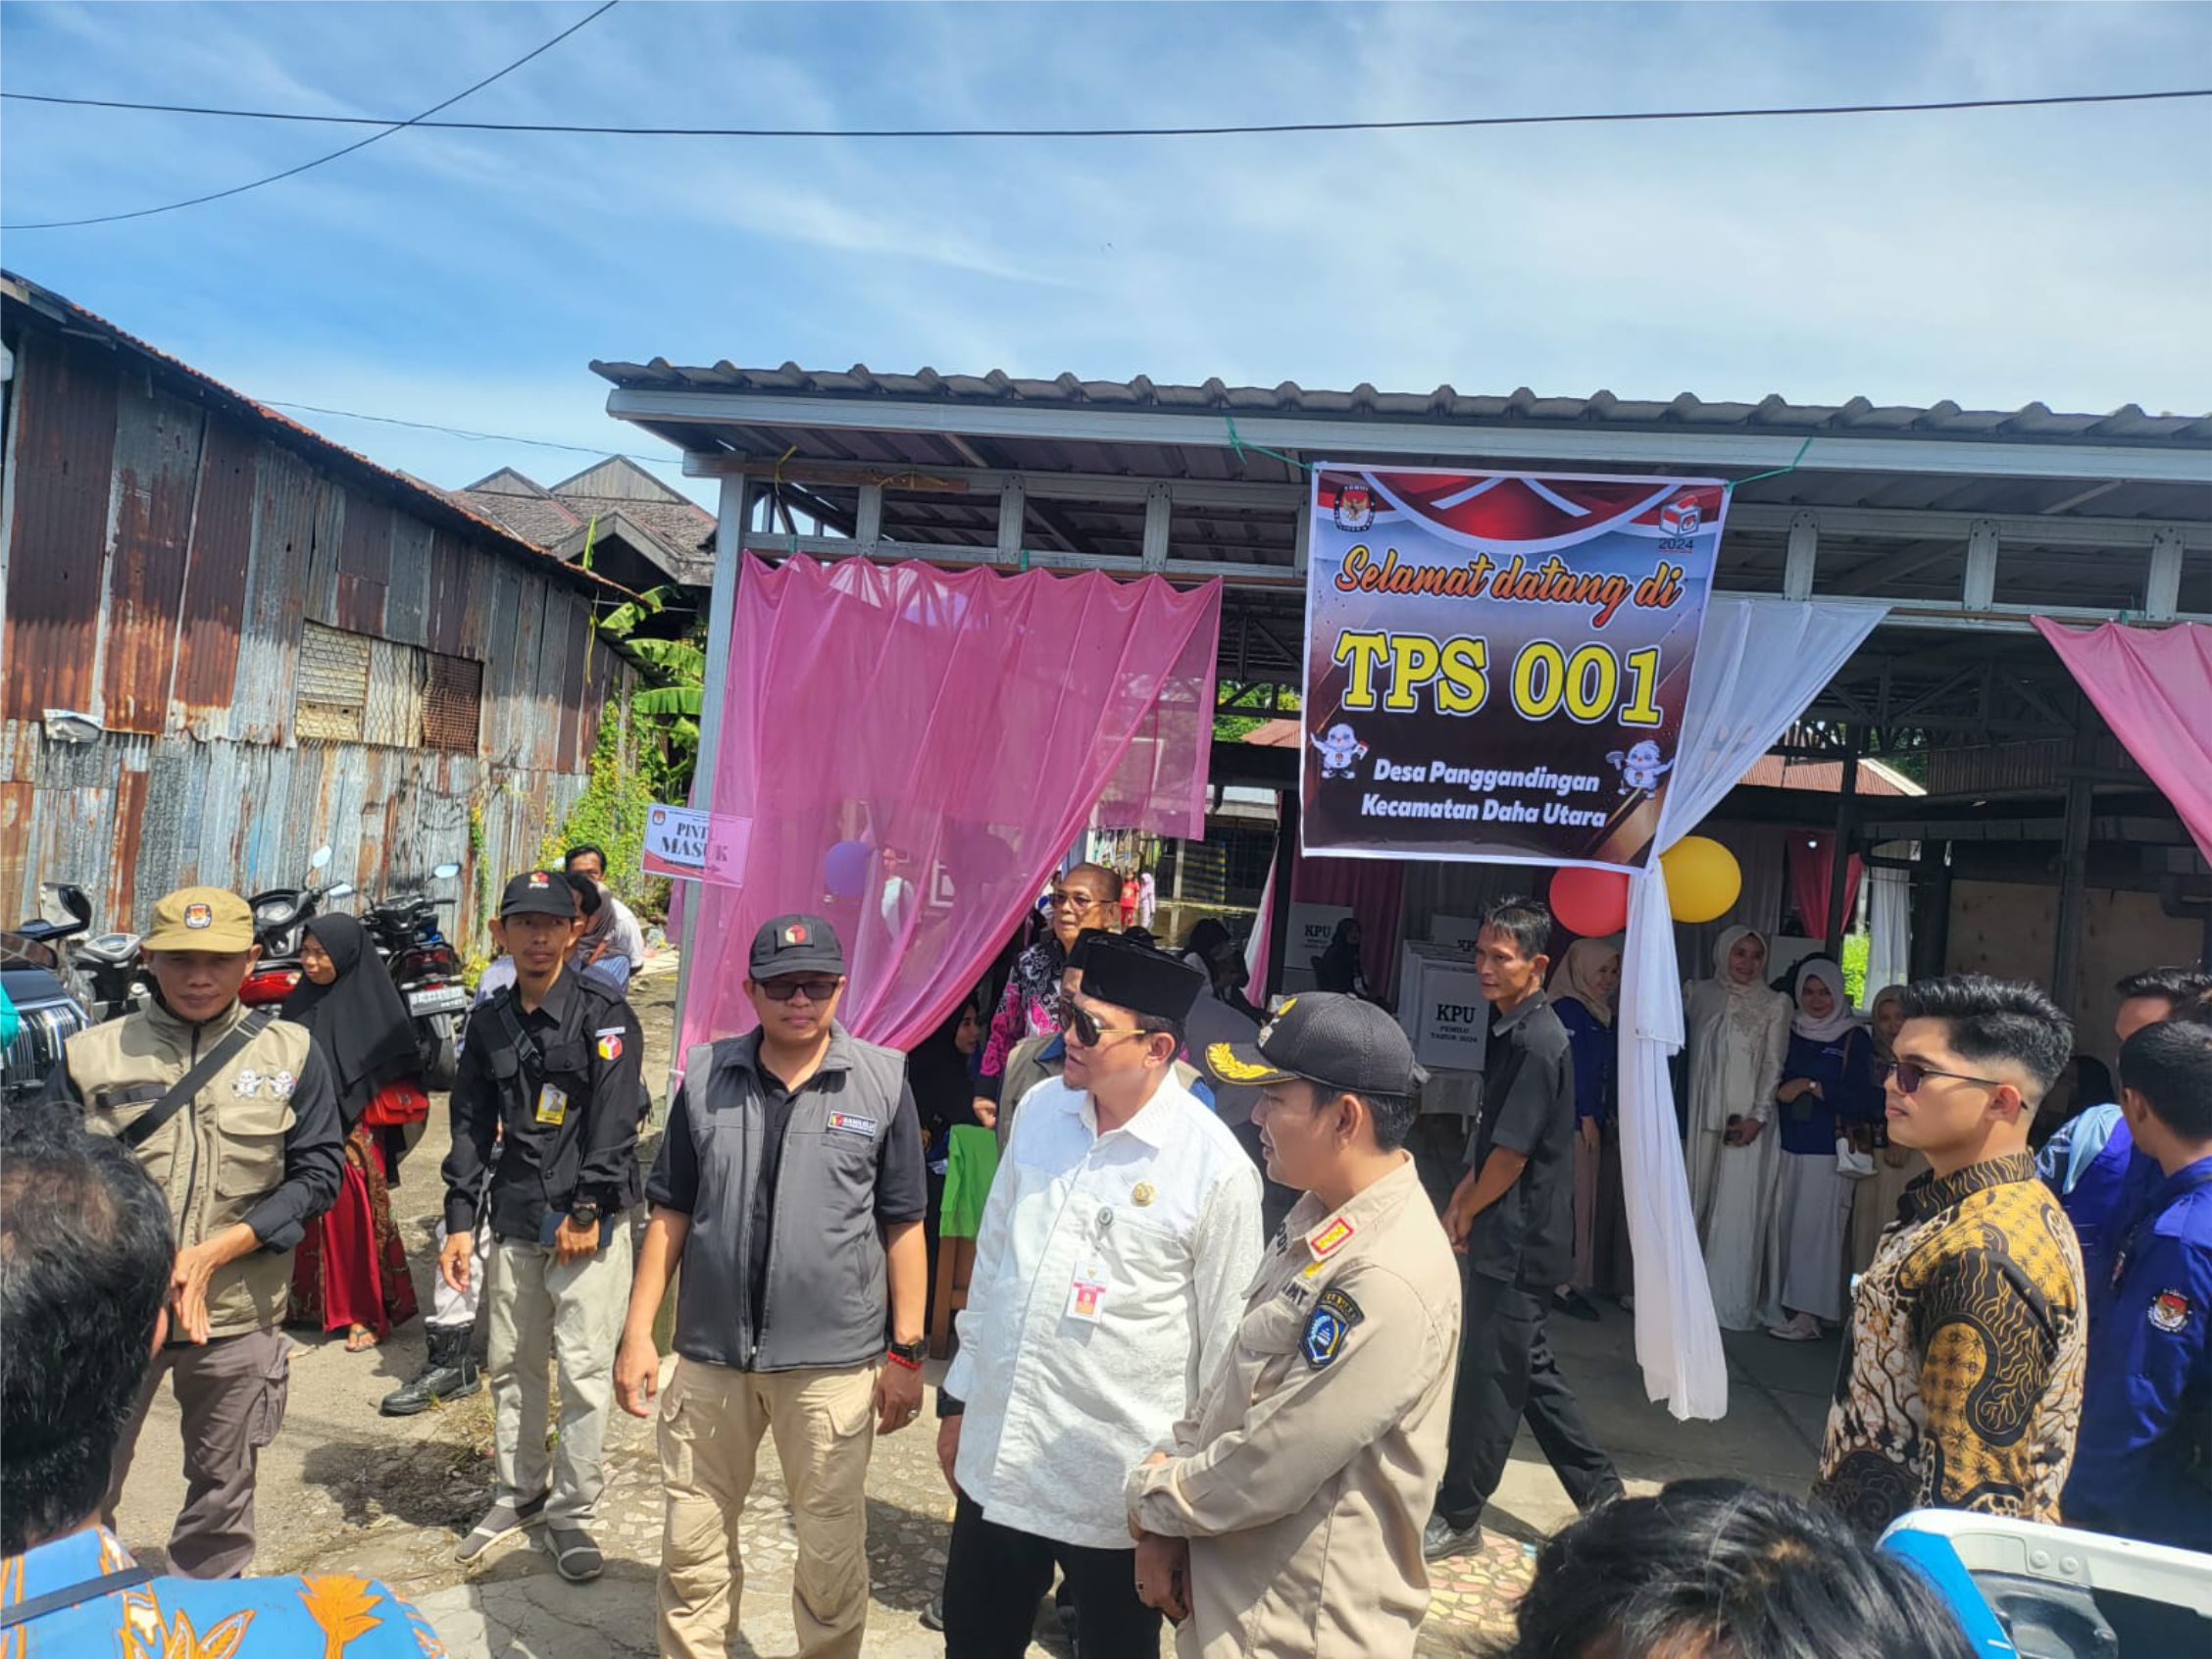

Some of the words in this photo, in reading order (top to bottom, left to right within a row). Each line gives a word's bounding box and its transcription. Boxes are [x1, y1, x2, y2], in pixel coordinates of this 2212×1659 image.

[1657, 537, 1694, 550] 2024
[1335, 544, 1493, 597] Selamat
[1490, 555, 1632, 628] datang
[1634, 562, 1684, 609] di
[1333, 630, 1488, 714] TPS
[1513, 641, 1663, 724] 001
[1374, 759, 1426, 782] Desa
[1429, 761, 1601, 795] Panggandingan
[1361, 793, 1480, 821] Kecamatan
[1482, 799, 1539, 823] Daha
[1543, 803, 1608, 828] Utara
[677, 823, 711, 839] PINT
[1304, 924, 1332, 938] KPU
[1457, 938, 1476, 952] KP
[1435, 1003, 1476, 1024] KPU
